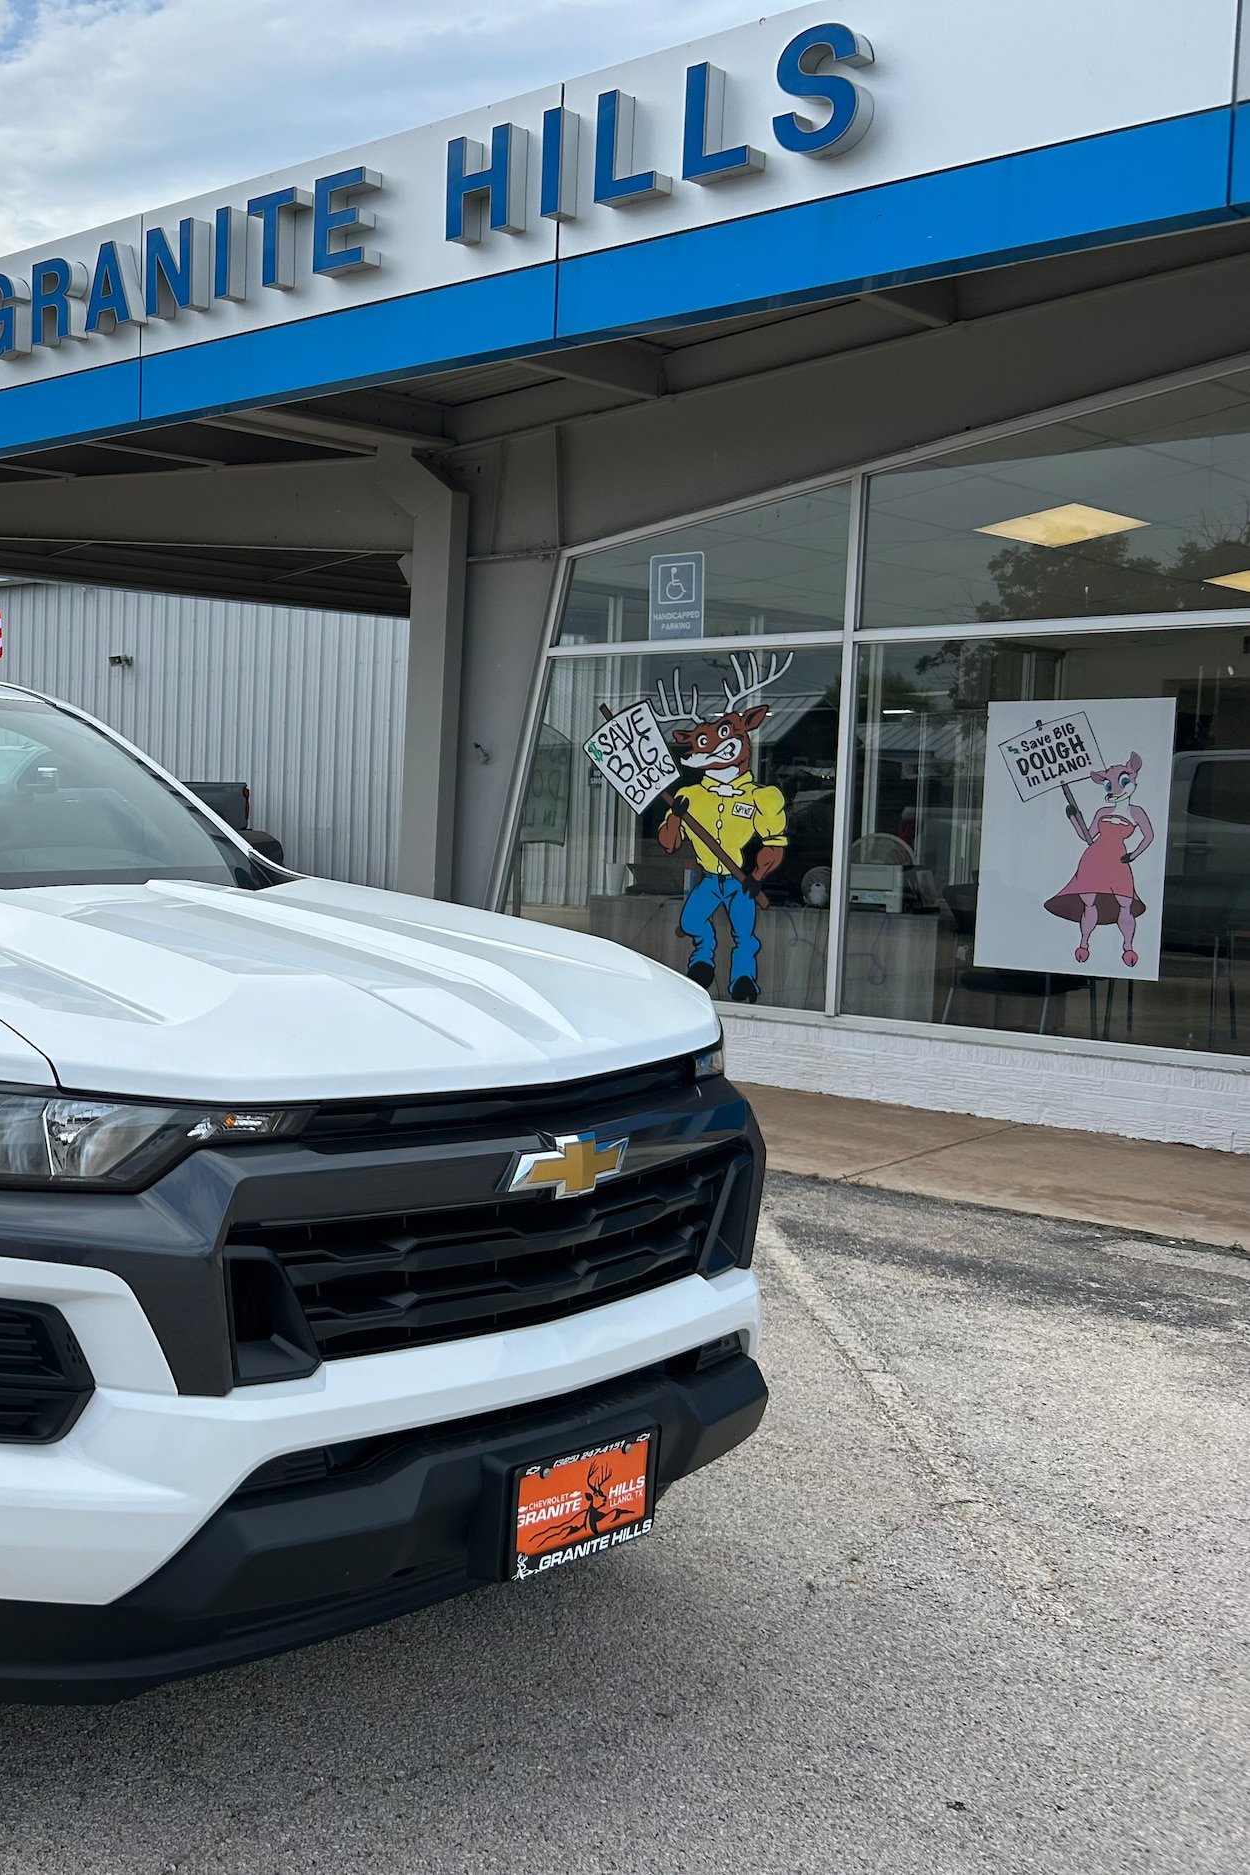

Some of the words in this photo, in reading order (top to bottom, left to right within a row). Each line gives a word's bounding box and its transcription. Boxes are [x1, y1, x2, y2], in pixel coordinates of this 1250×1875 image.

[445, 22, 875, 245] HILLS
[653, 610, 700, 621] HANDICAPPED
[661, 621, 691, 631] PARKING
[598, 708, 651, 756] SAVE
[1020, 734, 1051, 752] Save
[1053, 722, 1075, 740] BIG
[607, 735, 659, 783] BIG
[1016, 734, 1086, 776] DOUGH
[1026, 775, 1041, 787] in
[1041, 753, 1092, 782] LLANO!
[625, 754, 676, 805] BUCKS
[734, 804, 752, 816] SPIKE
[529, 1493, 569, 1511] CHEVROLET
[608, 1474, 646, 1500] HILLS
[635, 1489, 643, 1498] TX
[517, 1498, 582, 1528] GRANITE
[538, 1535, 610, 1571] GRANITE
[611, 1518, 653, 1546] HILLS
